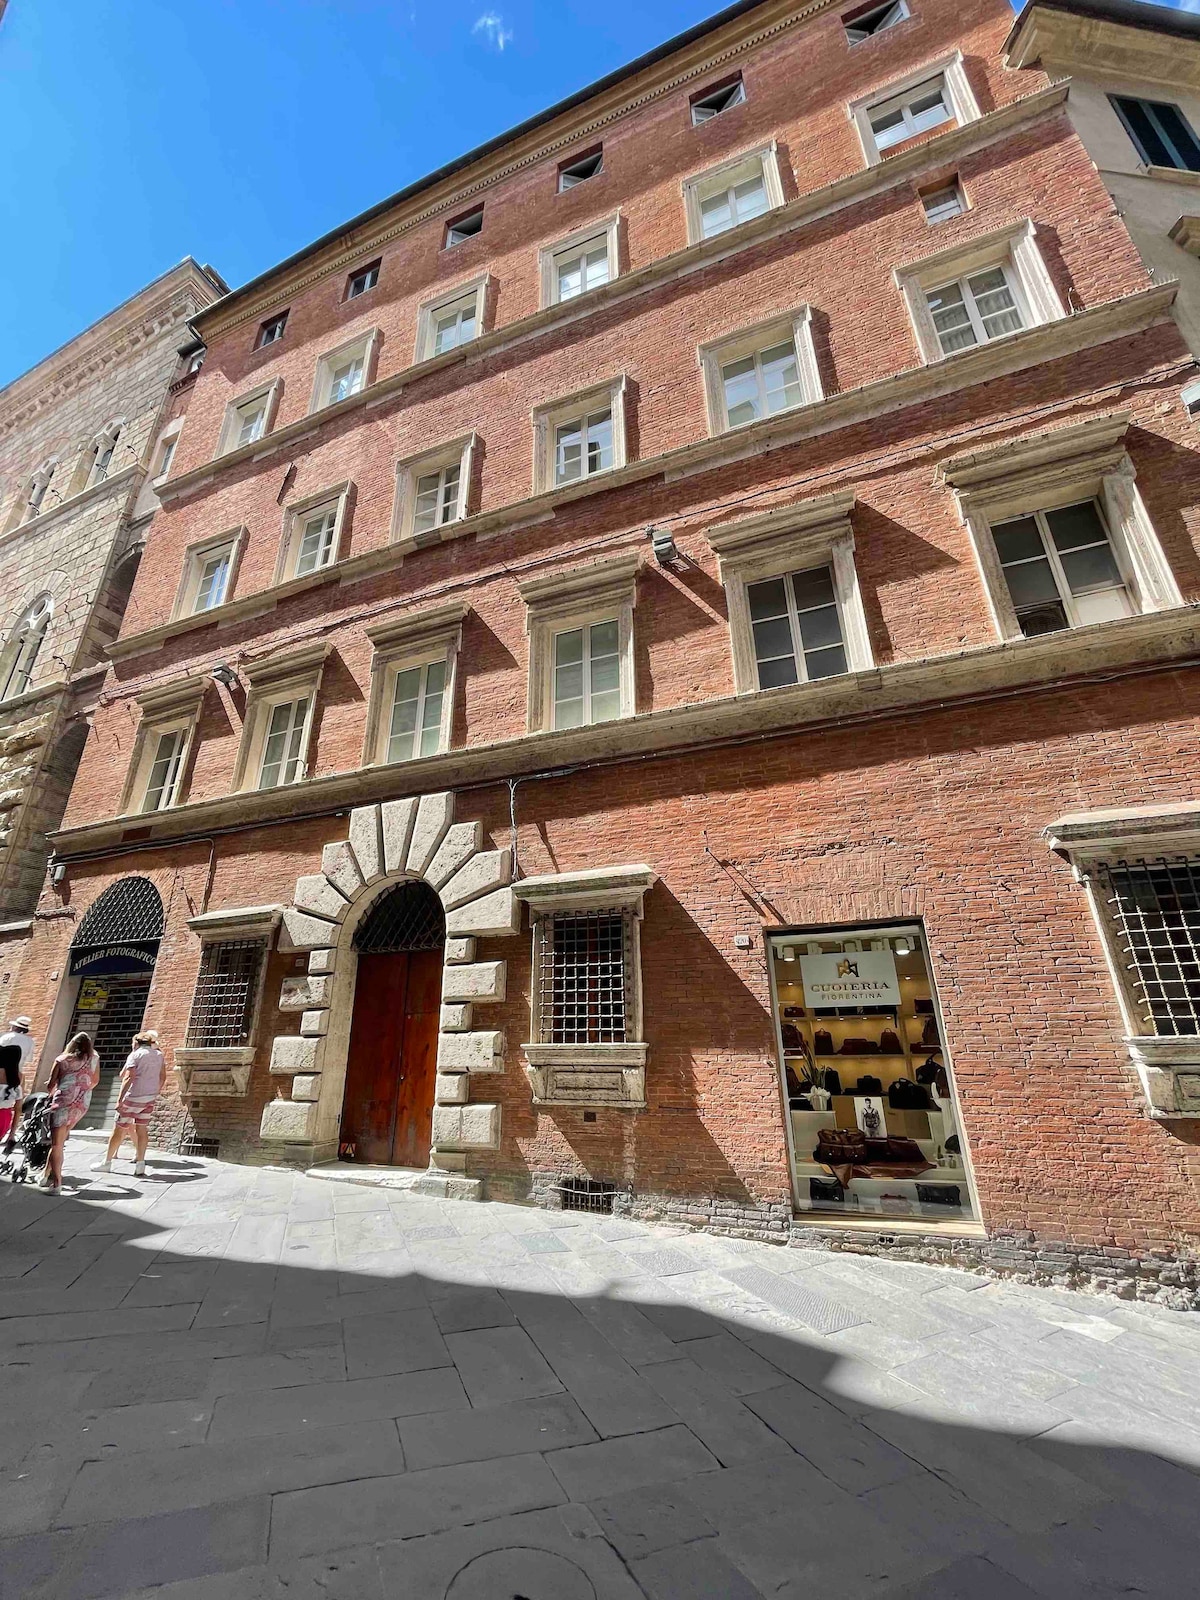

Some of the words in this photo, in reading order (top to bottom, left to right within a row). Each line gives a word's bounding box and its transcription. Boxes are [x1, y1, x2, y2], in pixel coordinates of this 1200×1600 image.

[73, 949, 105, 971] ATELIER
[105, 947, 156, 966] FOTOGRAFICO
[811, 982, 890, 992] CUOIERIA
